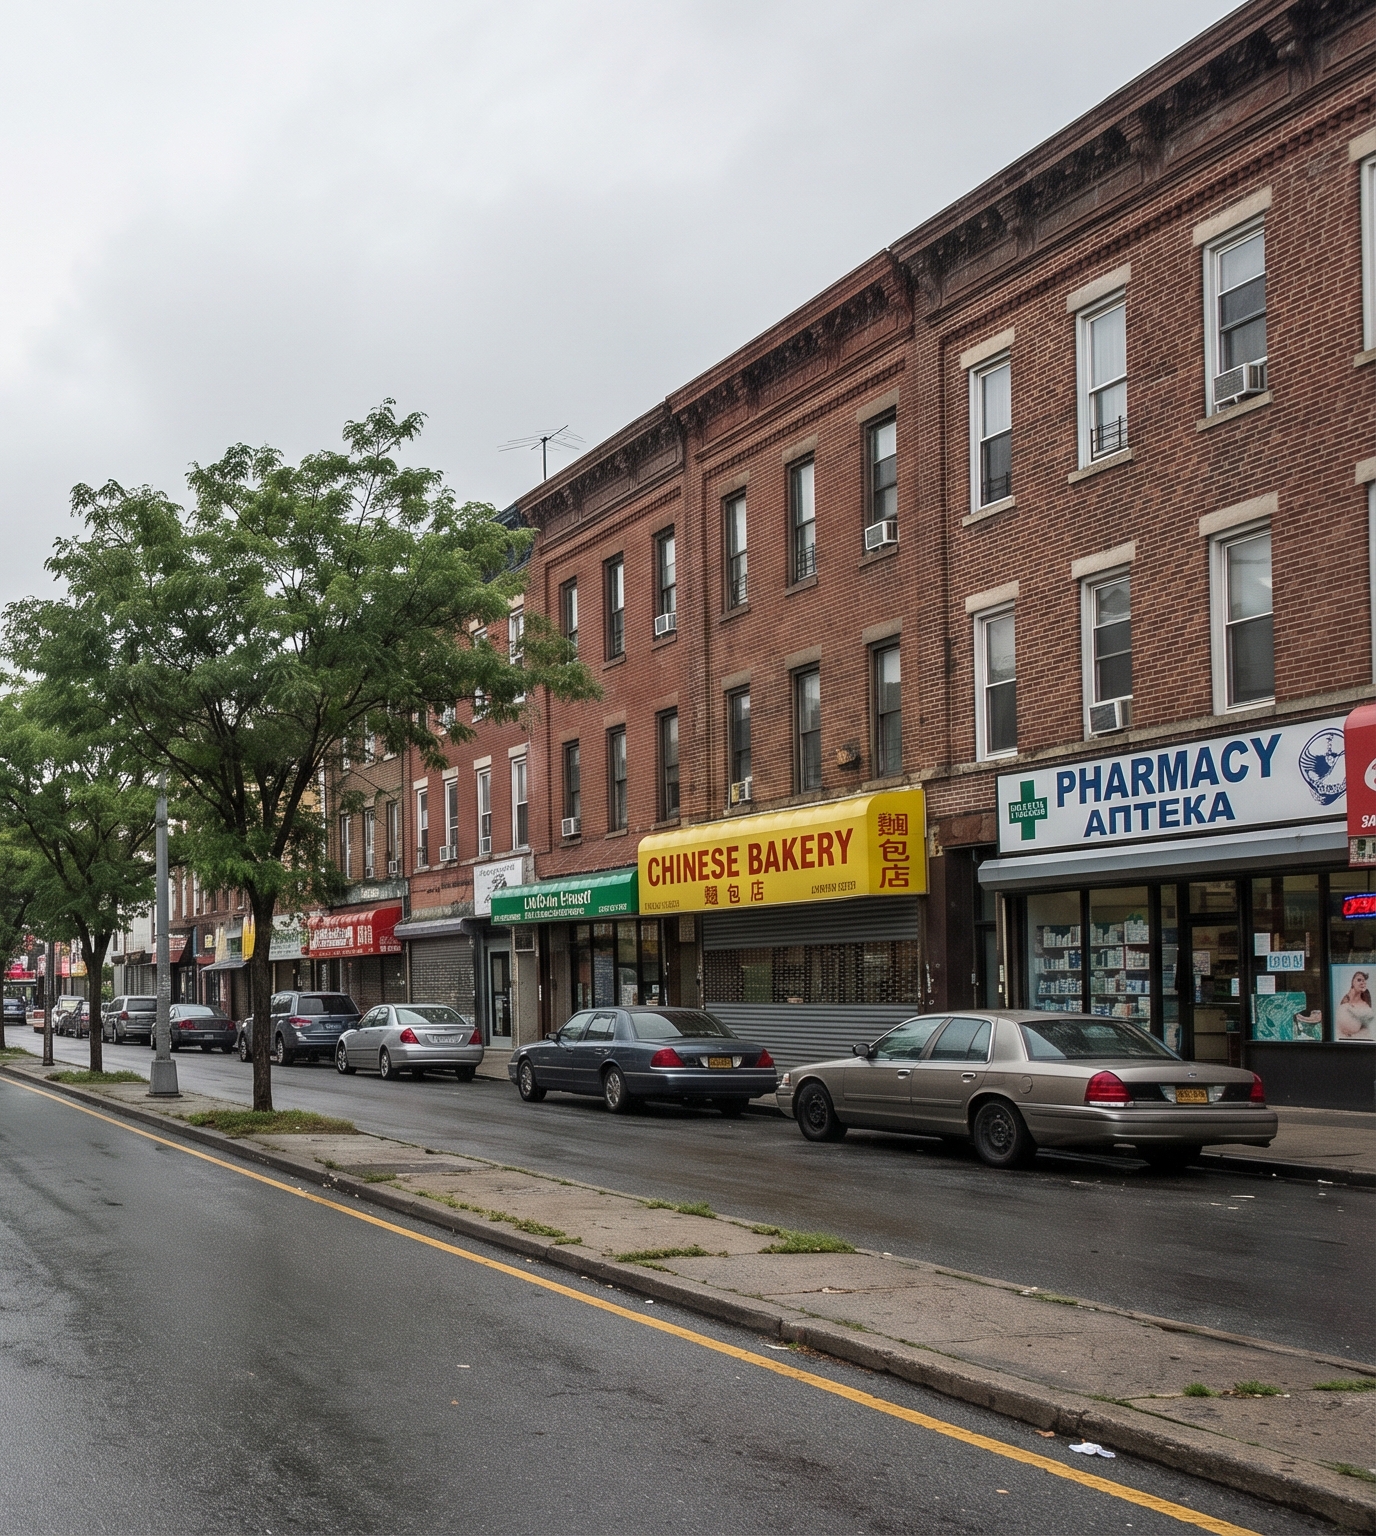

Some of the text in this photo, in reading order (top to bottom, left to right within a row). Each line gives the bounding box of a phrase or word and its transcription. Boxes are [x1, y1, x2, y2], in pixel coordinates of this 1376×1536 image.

[1055, 734, 1282, 808] PHARMACY
[1083, 791, 1236, 838] АПТЕКА
[647, 827, 854, 887] CHINESE BAKERY
